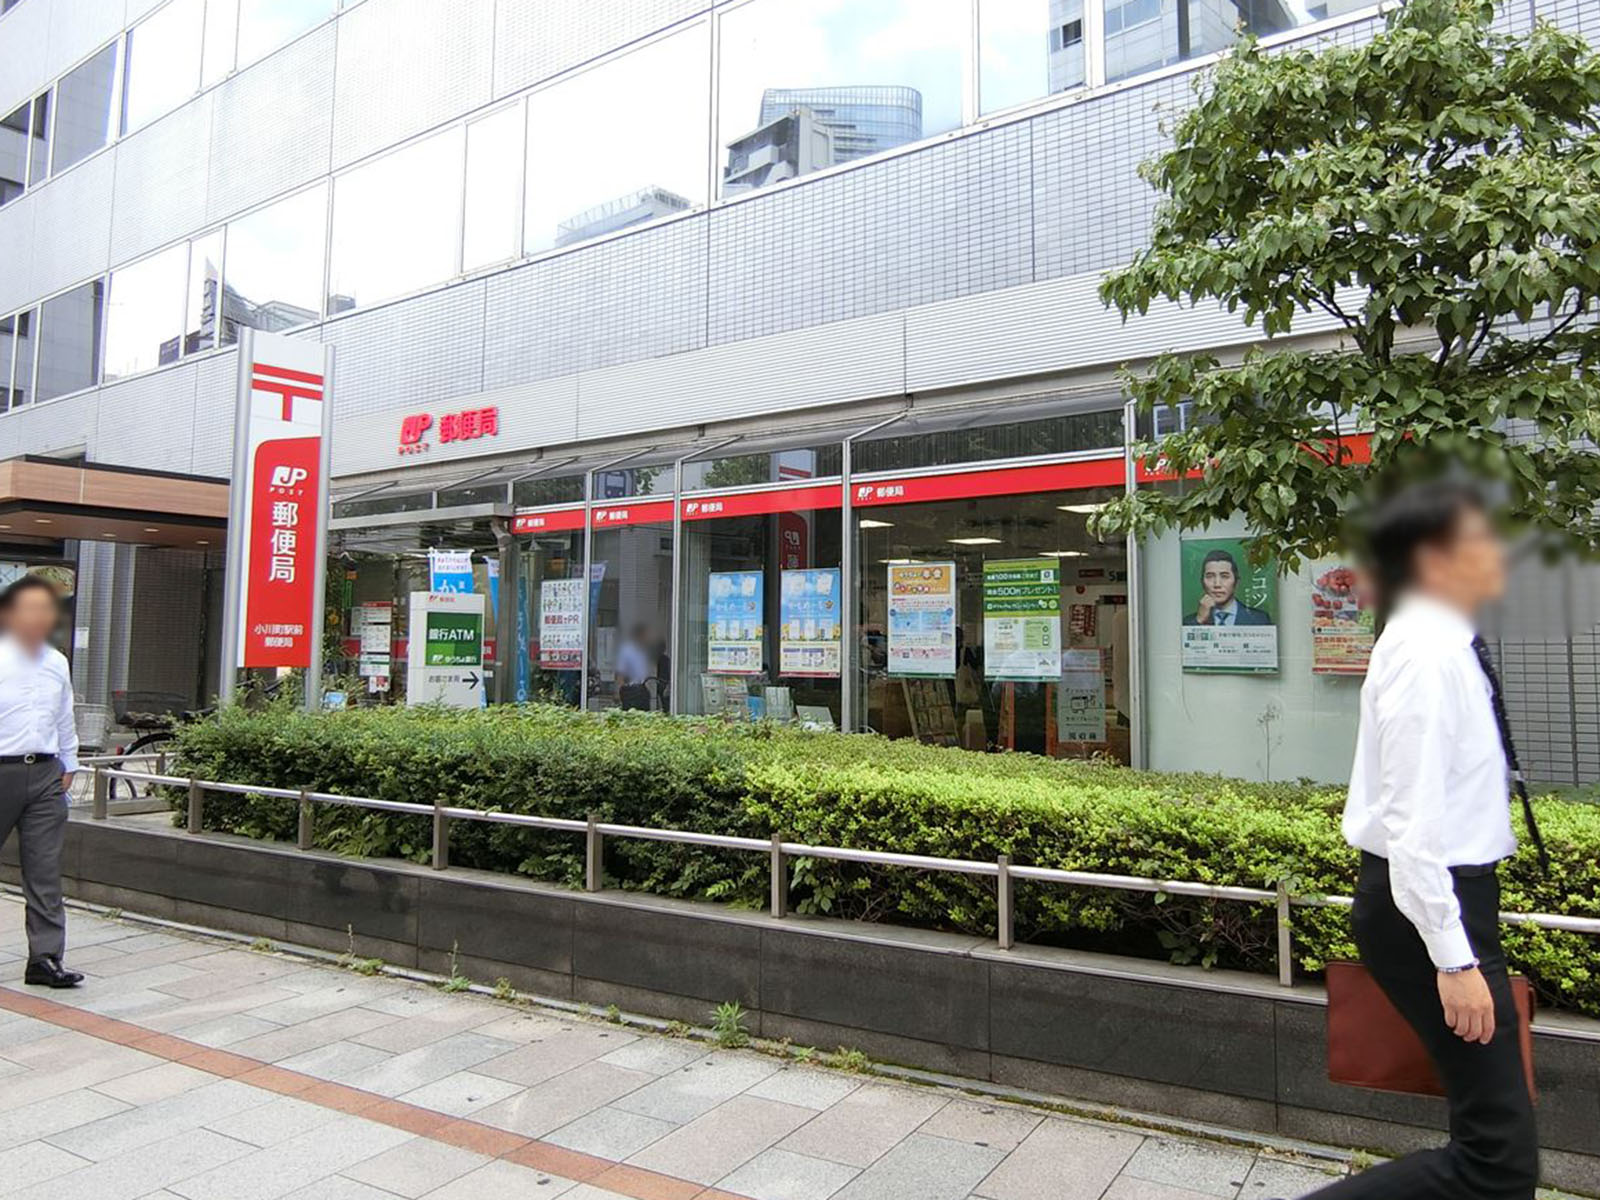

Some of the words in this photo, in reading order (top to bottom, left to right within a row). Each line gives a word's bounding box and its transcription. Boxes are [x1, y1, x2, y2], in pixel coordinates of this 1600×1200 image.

[400, 413, 433, 444] JP
[439, 405, 499, 444] 郵便局
[271, 466, 308, 487] JP
[269, 486, 304, 497] POST
[876, 485, 905, 498] 郵便局
[701, 501, 724, 514] 郵便局
[609, 509, 629, 521] 郵便局
[268, 501, 299, 583] 郵便局
[253, 623, 305, 636] 小川町駅前
[428, 628, 475, 641] 銀行ATM
[264, 636, 294, 648] 郵便局
